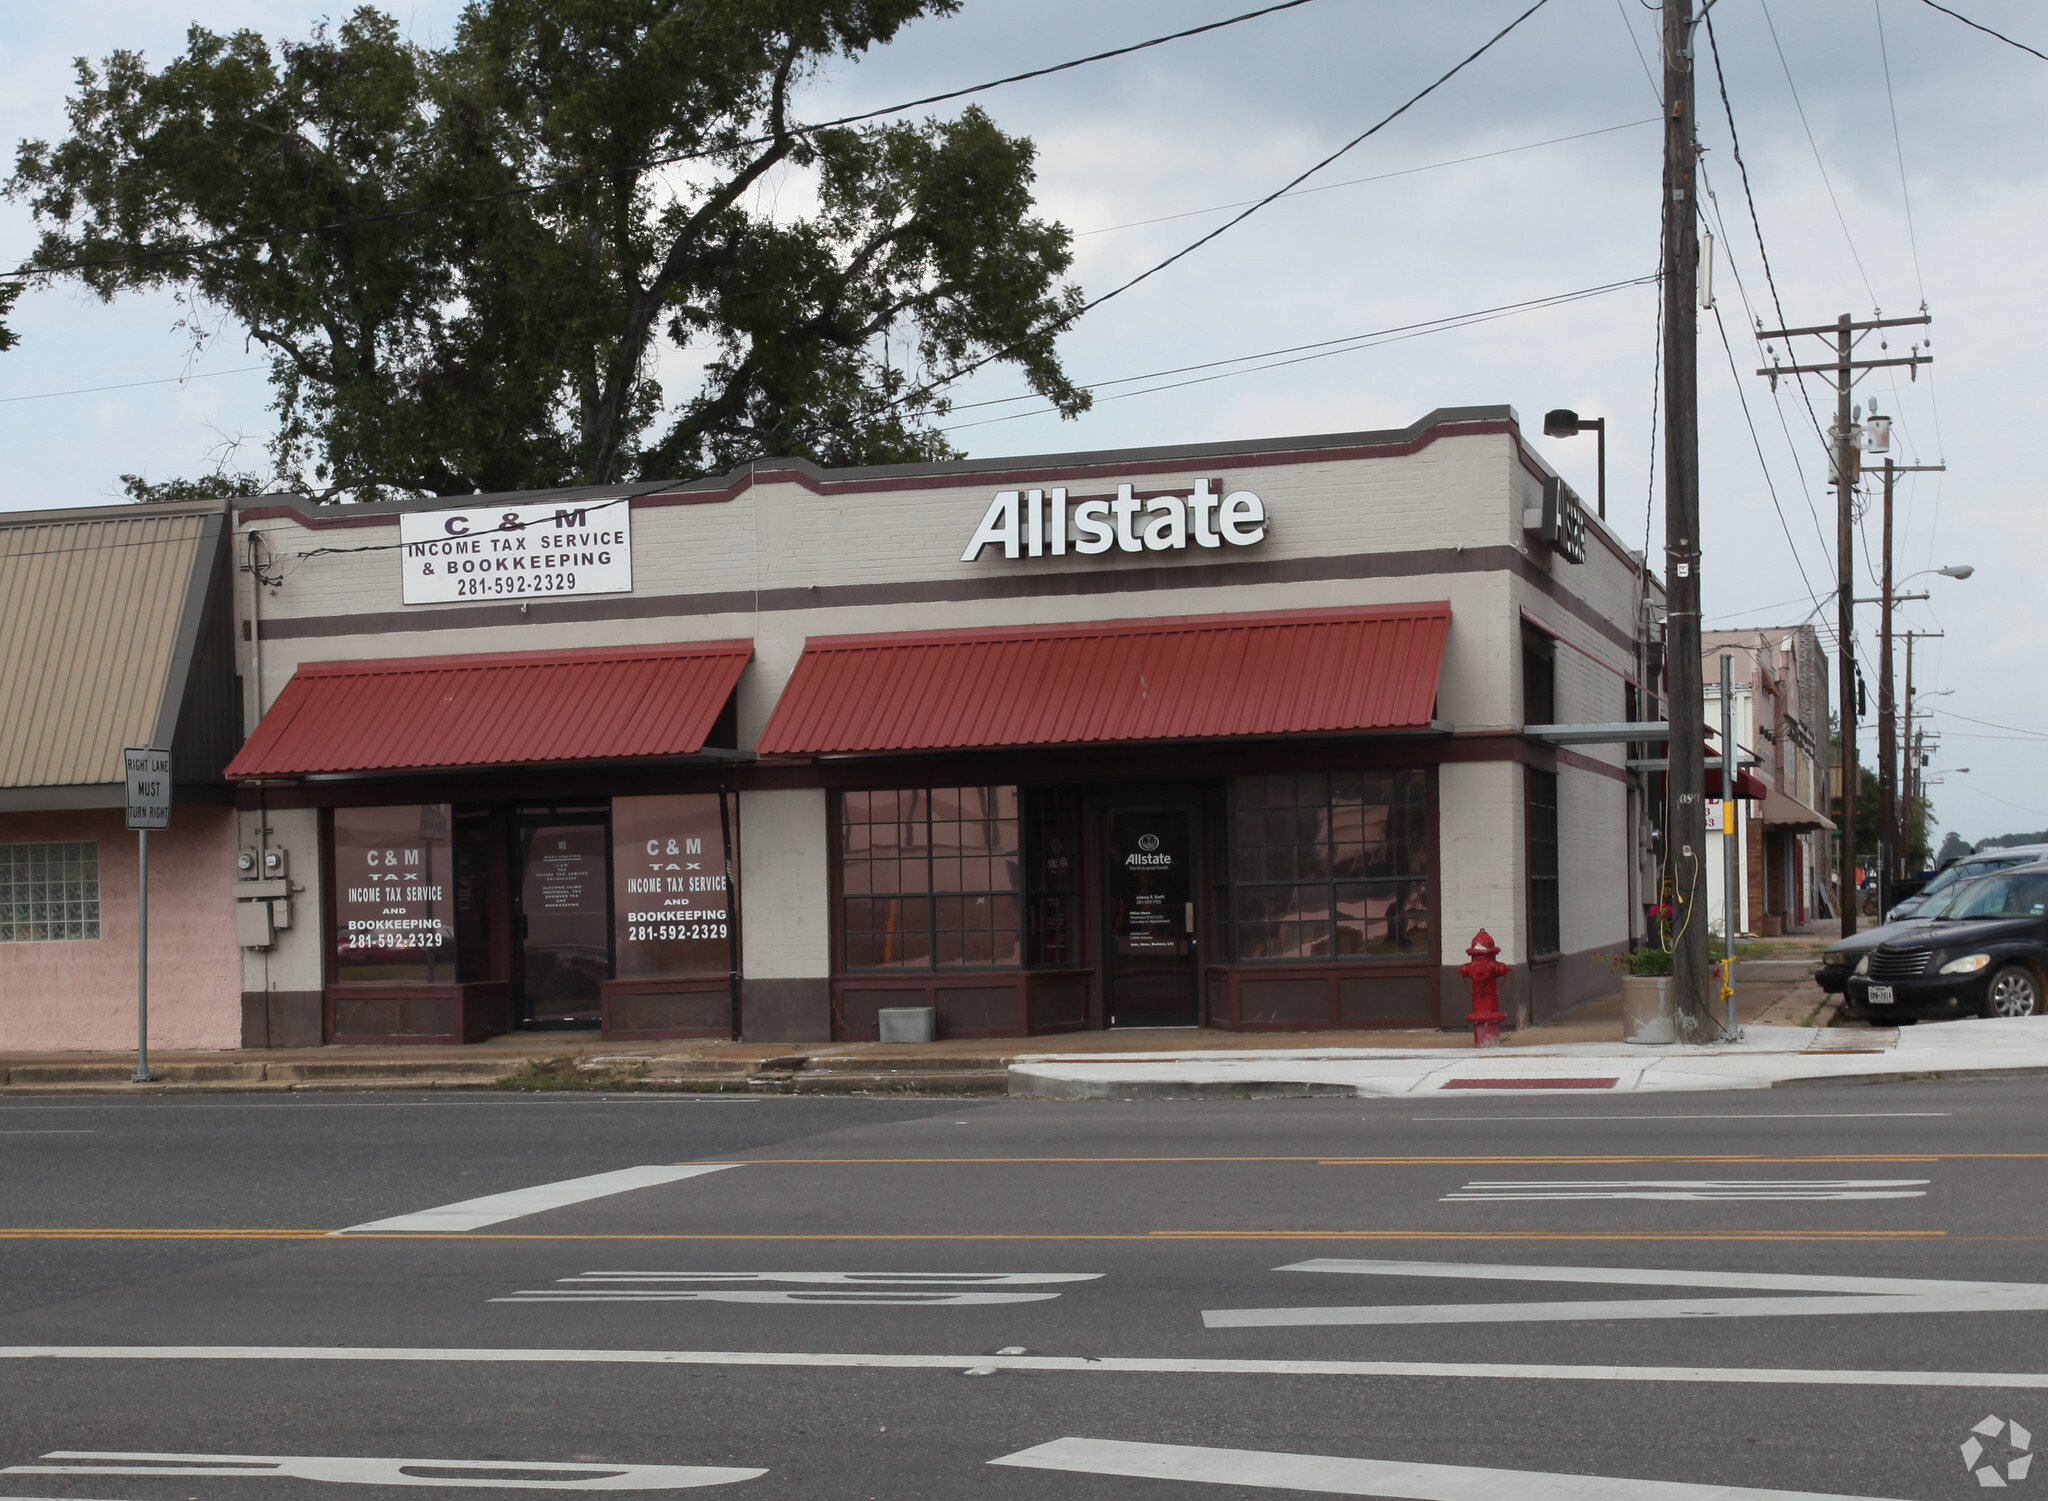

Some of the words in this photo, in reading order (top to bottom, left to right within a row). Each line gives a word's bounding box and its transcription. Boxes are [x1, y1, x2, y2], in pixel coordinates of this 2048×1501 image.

[445, 516, 470, 535] C
[499, 512, 526, 532] &
[555, 508, 586, 528] M
[959, 478, 1265, 562] Allstate
[409, 540, 481, 557] INCOME
[491, 537, 526, 552] TAX
[541, 531, 624, 549] SERVICE
[422, 562, 435, 575] &
[447, 551, 612, 574] BOOKKEEPING
[458, 573, 576, 596] 281-592-2329
[128, 759, 148, 771] RIGHT
[151, 760, 169, 772] LANE
[138, 781, 160, 797] MUST
[129, 806, 147, 818] TURN
[149, 807, 169, 819] RIGHT
[647, 839, 659, 856] C
[666, 839, 679, 855] &
[686, 838, 701, 854] M
[367, 850, 379, 866] C
[384, 850, 398, 866] &
[404, 849, 419, 865] M
[1125, 853, 1172, 865] Allstate
[648, 862, 701, 871] TAX
[368, 873, 418, 881] TAX
[628, 877, 661, 893] INCOME
[667, 877, 683, 892] TAX
[689, 875, 727, 892] SERVICE
[348, 887, 380, 902] INCOME
[385, 887, 401, 901] TAX
[407, 886, 442, 901] SERVICE
[628, 910, 727, 922] BOOKKEEPING
[348, 919, 442, 930] BOOKKEEPING
[629, 924, 727, 941] 281-592-2329
[349, 933, 442, 948] 281-592-2329
